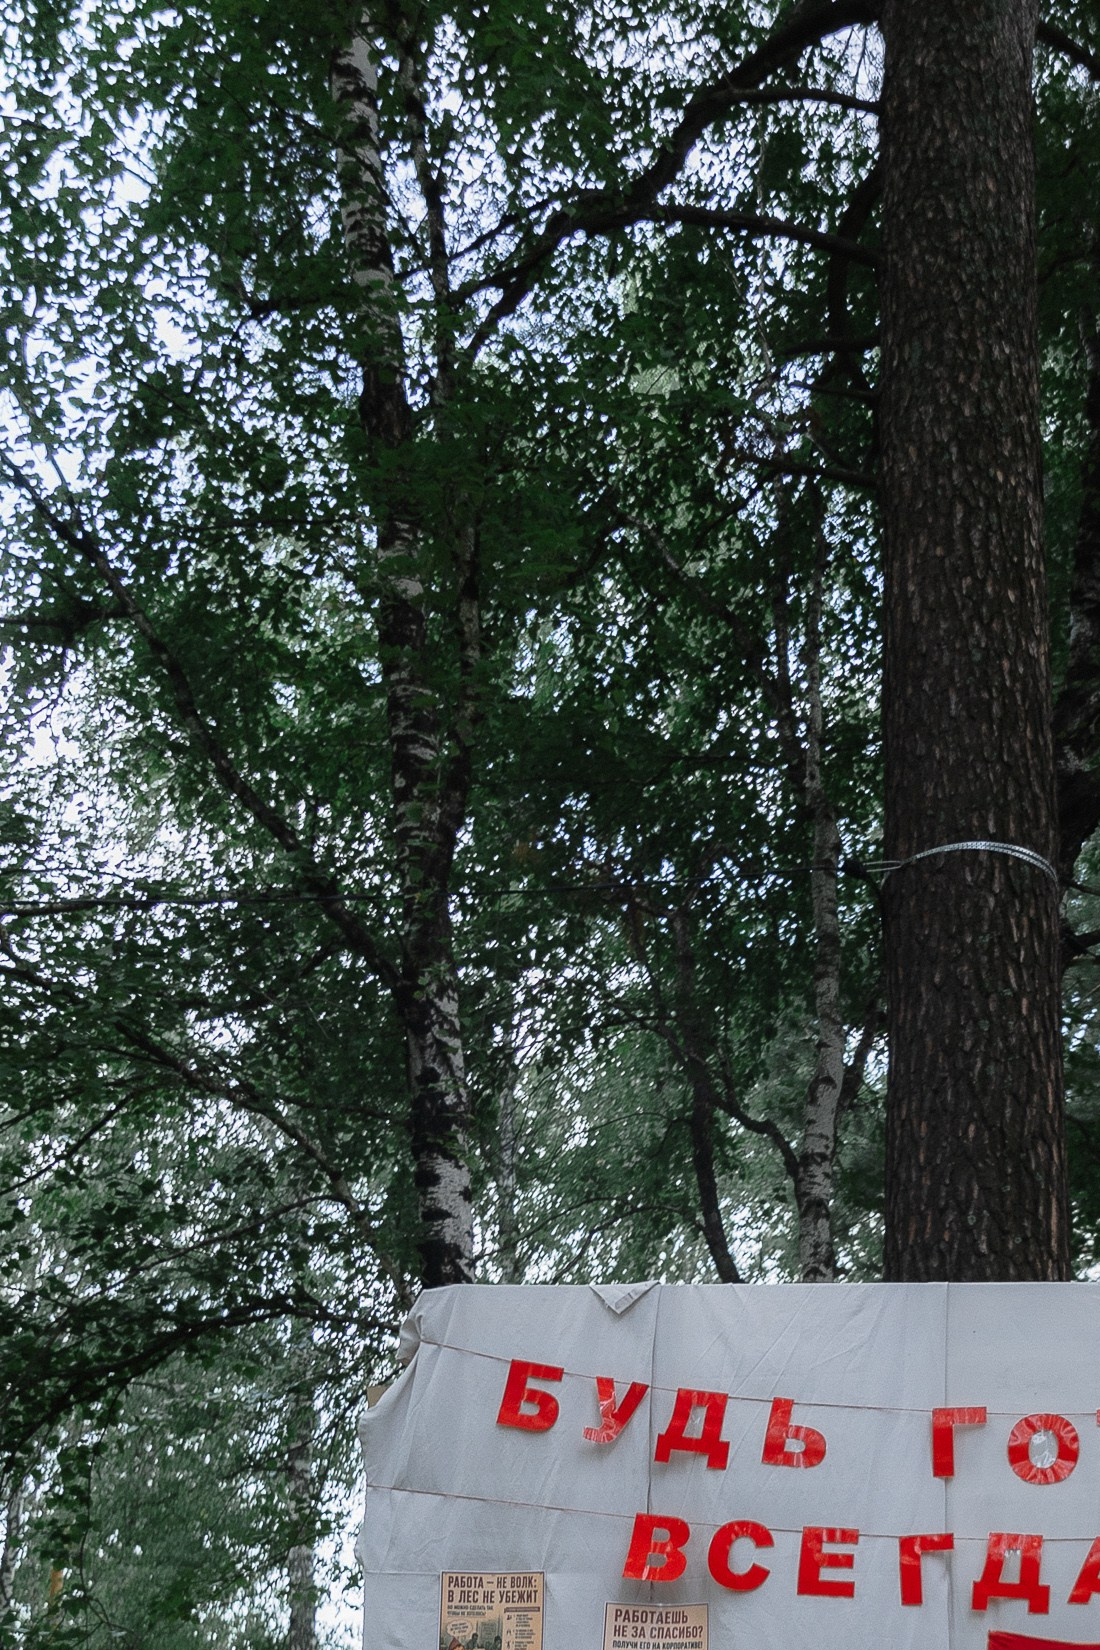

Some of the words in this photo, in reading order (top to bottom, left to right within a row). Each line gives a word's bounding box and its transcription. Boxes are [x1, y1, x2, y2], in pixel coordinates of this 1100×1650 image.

[496, 1358, 827, 1469] БУДЬ
[447, 1575, 484, 1589] РАБОТА
[496, 1576, 507, 1589] НЕ
[510, 1575, 537, 1589] ВОЛК:
[447, 1589, 454, 1603] В
[458, 1589, 479, 1603] ЛЕС
[482, 1590, 495, 1604] НЕ
[499, 1589, 538, 1603] УБЕЖИТ
[614, 1608, 688, 1625] РАБОТАЕШЬ
[613, 1624, 628, 1637] НЕ
[631, 1625, 646, 1639] ЗА
[649, 1625, 703, 1639] СПАСИБО?
[612, 1640, 638, 1649] ПОЛУЧИ
[640, 1641, 651, 1649] ЕГО
[652, 1642, 660, 1650] НА
[662, 1641, 703, 1650] КОРПОРАТИВЕ!
